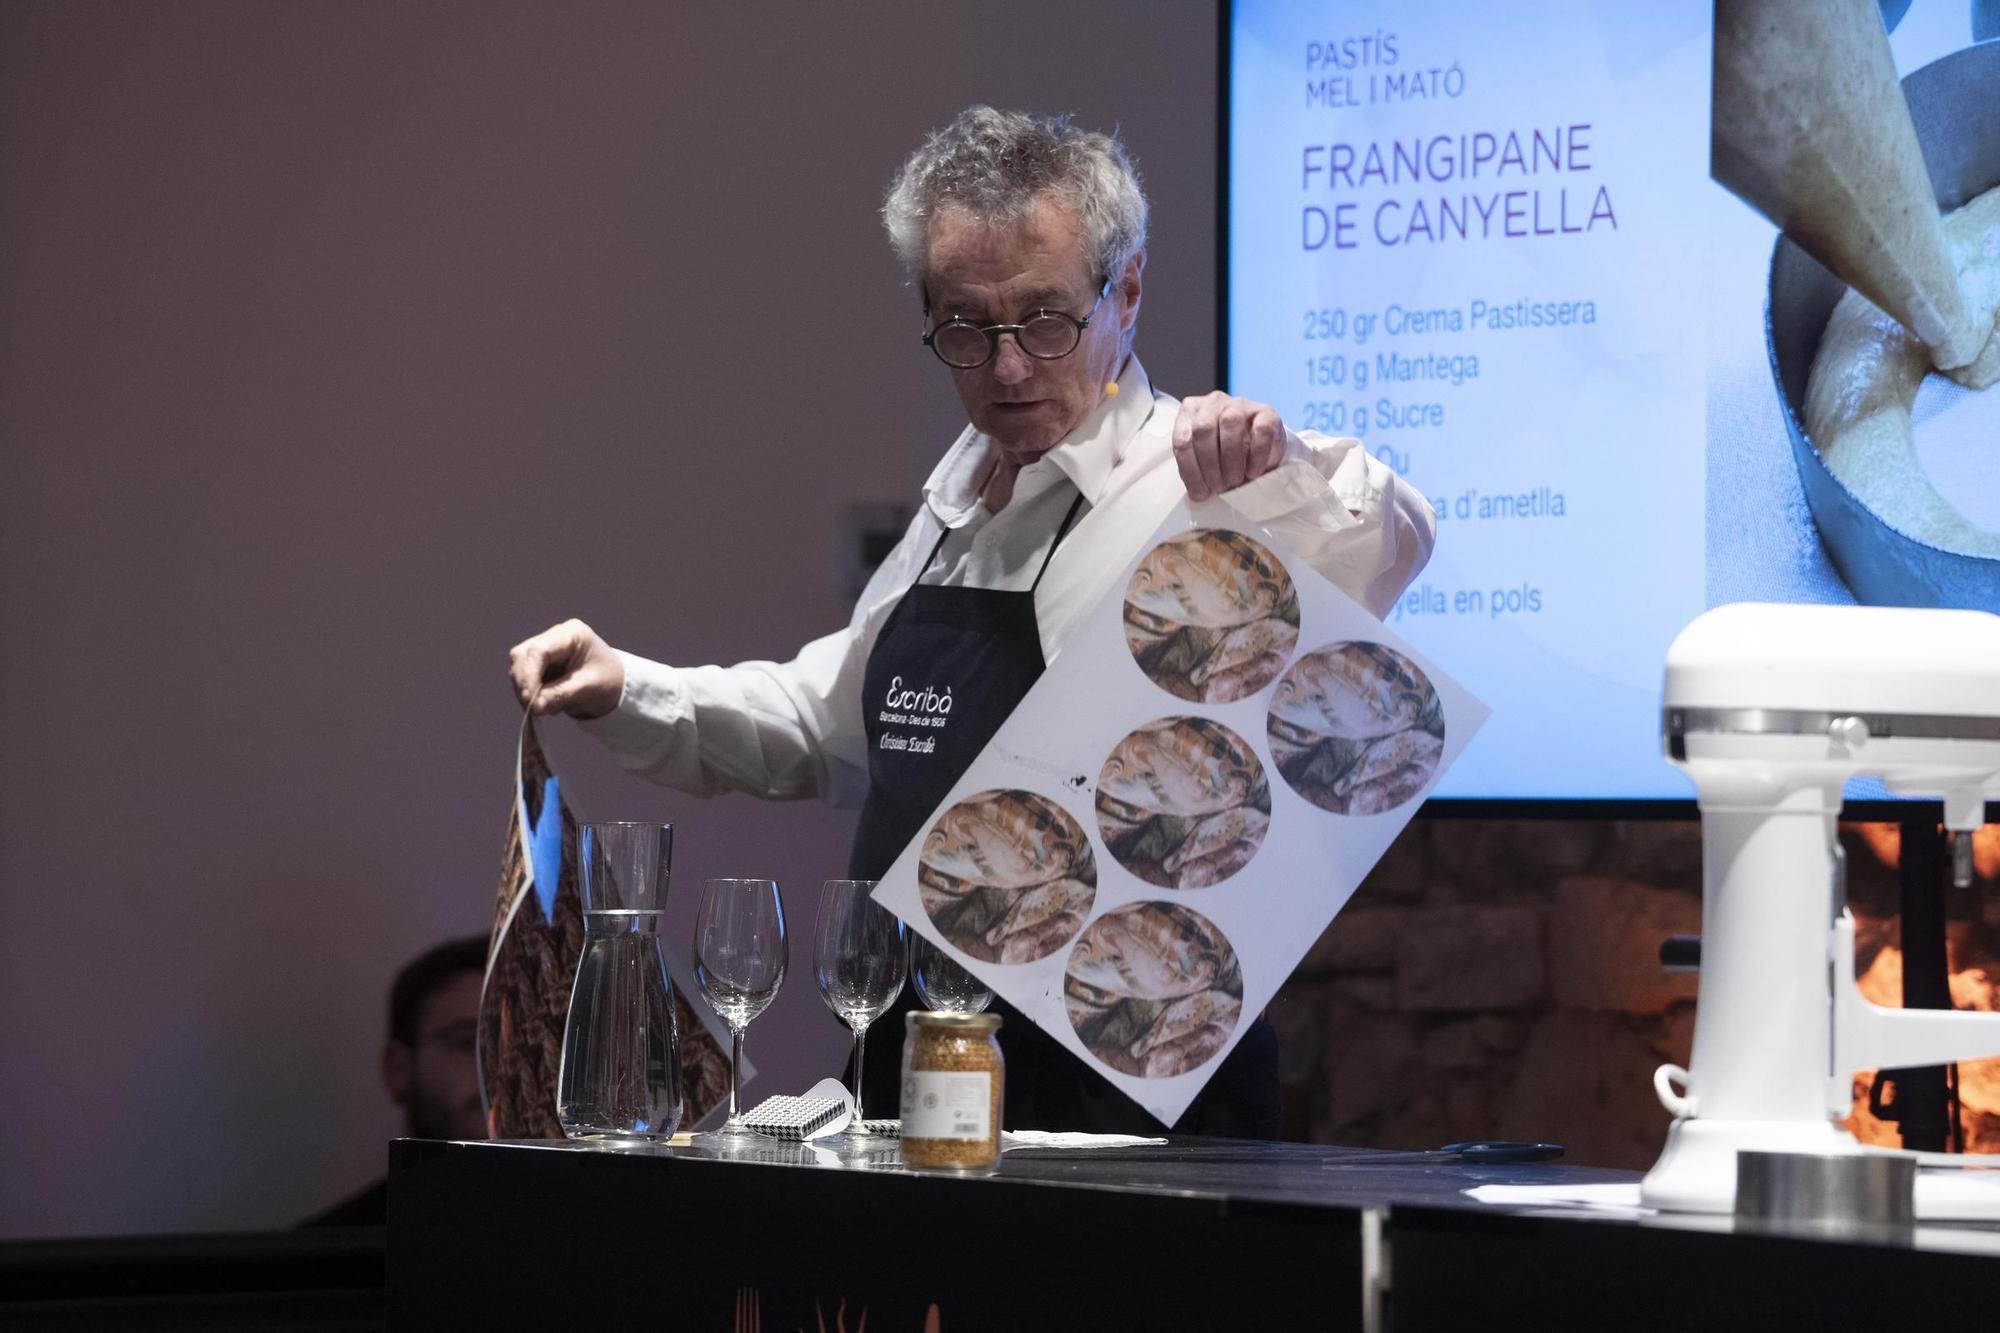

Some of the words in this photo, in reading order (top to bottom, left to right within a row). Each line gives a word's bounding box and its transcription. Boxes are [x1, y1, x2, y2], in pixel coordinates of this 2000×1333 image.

[1306, 27, 1399, 72] PASTÍS
[1306, 76, 1360, 109] MEL
[1369, 75, 1377, 105] I
[1385, 58, 1466, 104] MATÓ
[1302, 124, 1593, 191] FRANGIPANE
[1302, 204, 1360, 251] DE
[1373, 184, 1618, 247] CANYELLA
[1303, 307, 1346, 340] 250
[1353, 311, 1379, 345] gr
[1384, 303, 1463, 336] Crema
[1470, 297, 1596, 331] Pastissera
[1305, 355, 1346, 386] 150
[1353, 360, 1368, 391] g
[1376, 352, 1479, 386] Mantega
[1303, 401, 1346, 432] 250
[1353, 406, 1368, 437] g
[1375, 398, 1444, 430] Sucre
[1455, 487, 1566, 520] d'ametlla
[1454, 589, 1483, 614] en
[1491, 581, 1542, 620] pols
[886, 676, 953, 714] Escribà
